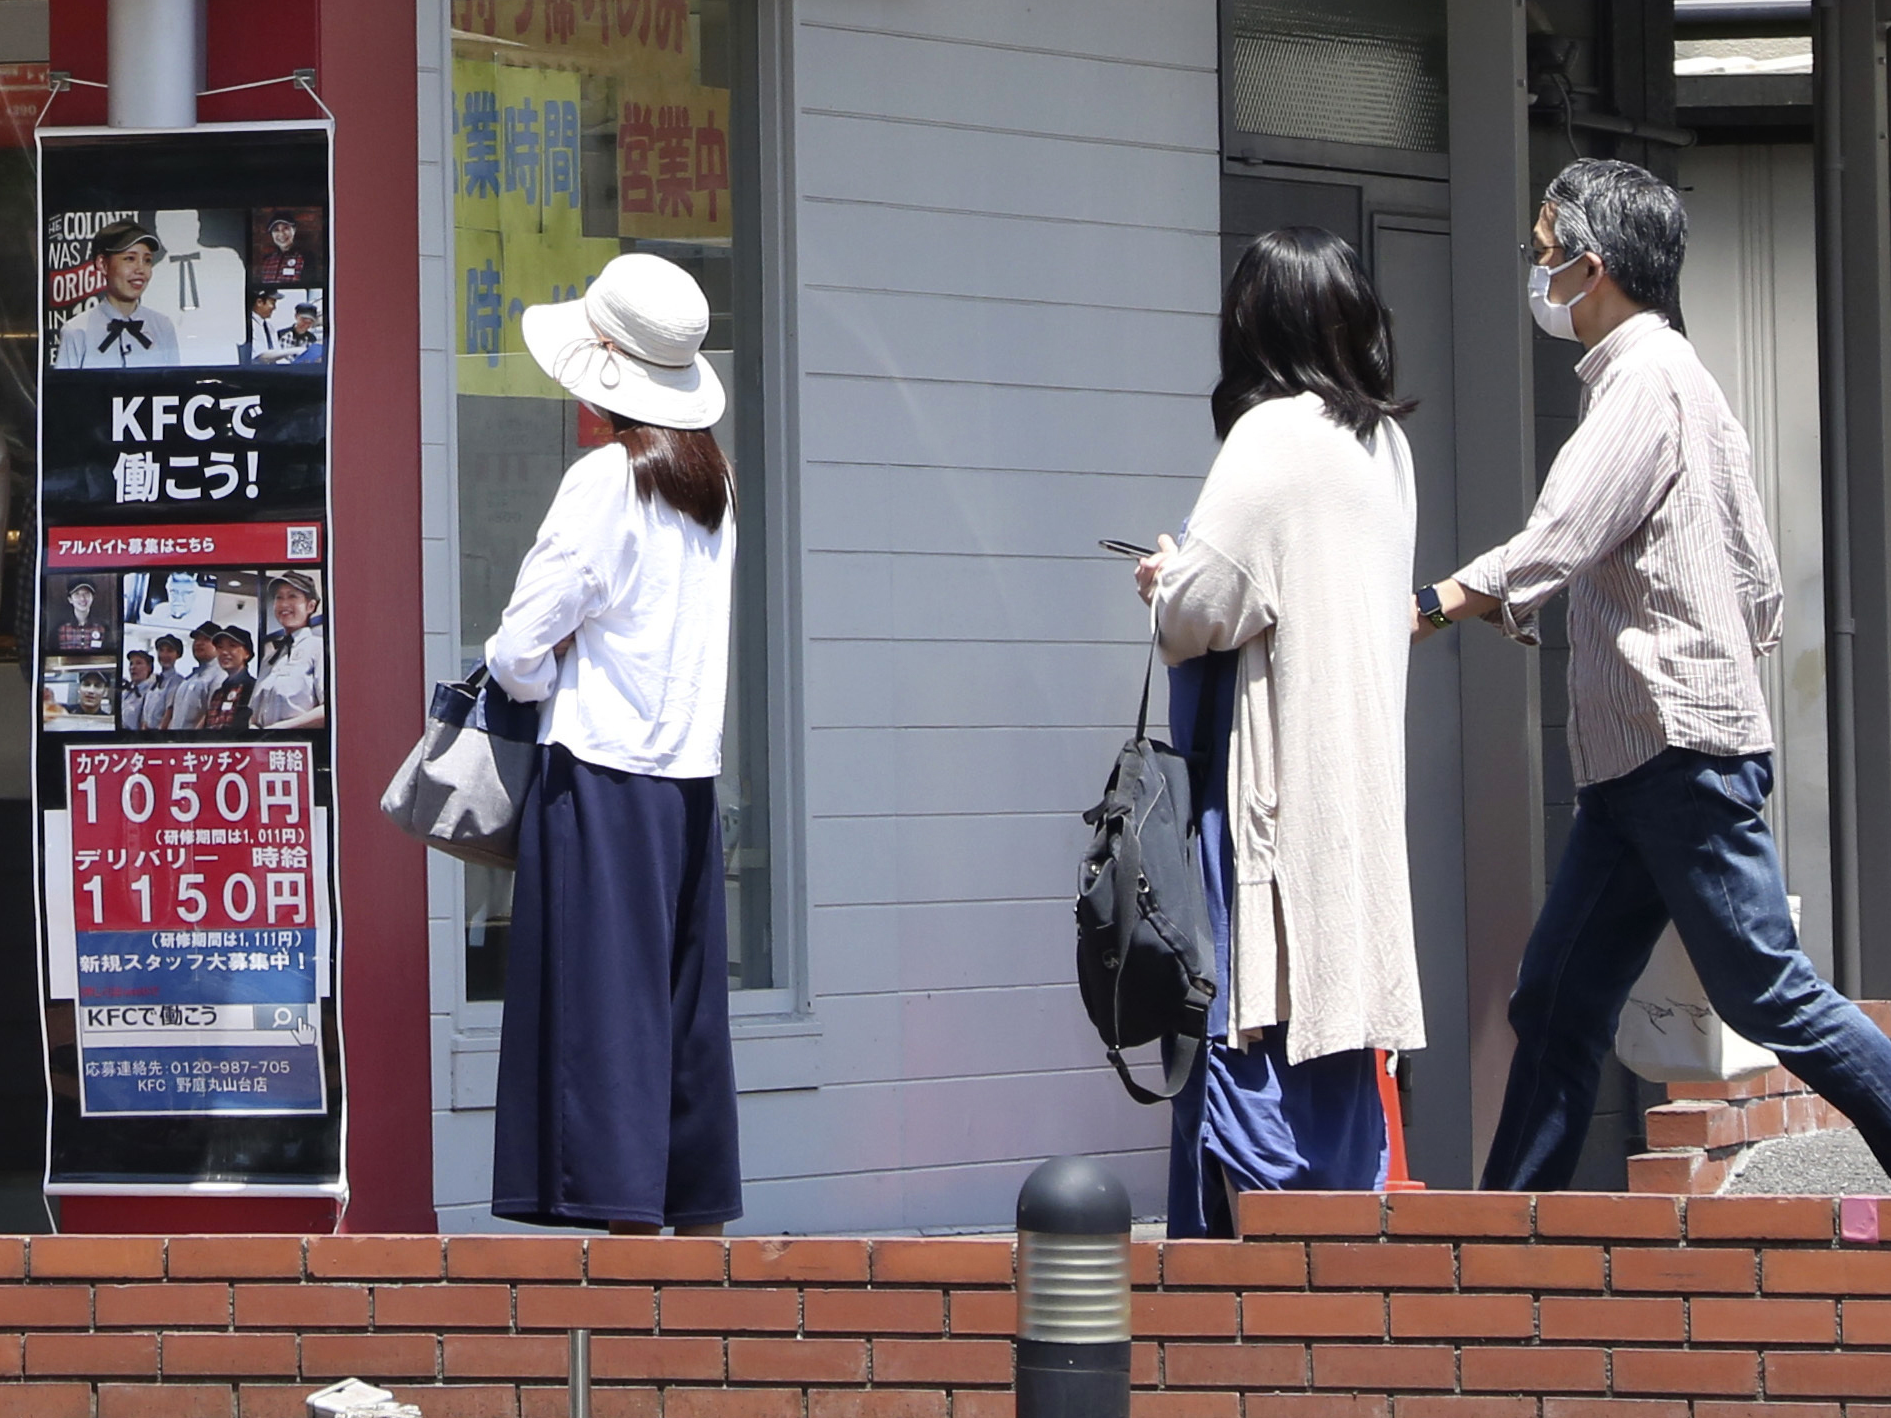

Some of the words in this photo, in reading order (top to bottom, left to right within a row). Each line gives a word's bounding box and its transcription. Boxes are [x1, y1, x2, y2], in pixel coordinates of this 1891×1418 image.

[618, 102, 728, 222] 営業中
[112, 394, 263, 443] KFCで
[112, 451, 260, 504] 働こう!
[57, 536, 215, 556] アルバイト募集はこちら
[76, 751, 252, 773] カウンター・キッチン
[268, 749, 304, 773] 時給
[77, 771, 301, 825] 1050円
[155, 827, 306, 846] (研修期間は1,011円)
[75, 849, 219, 870] デリバリー
[252, 847, 308, 870] 時給
[82, 872, 308, 924] 1150円
[150, 930, 303, 949] (研修期間は1,111円)
[79, 951, 306, 974] 新規スタッフ大募集中!
[87, 1005, 218, 1028] KFCで働こう
[137, 1079, 166, 1092] KFC
[175, 1077, 268, 1094] 野庭丸山台店
